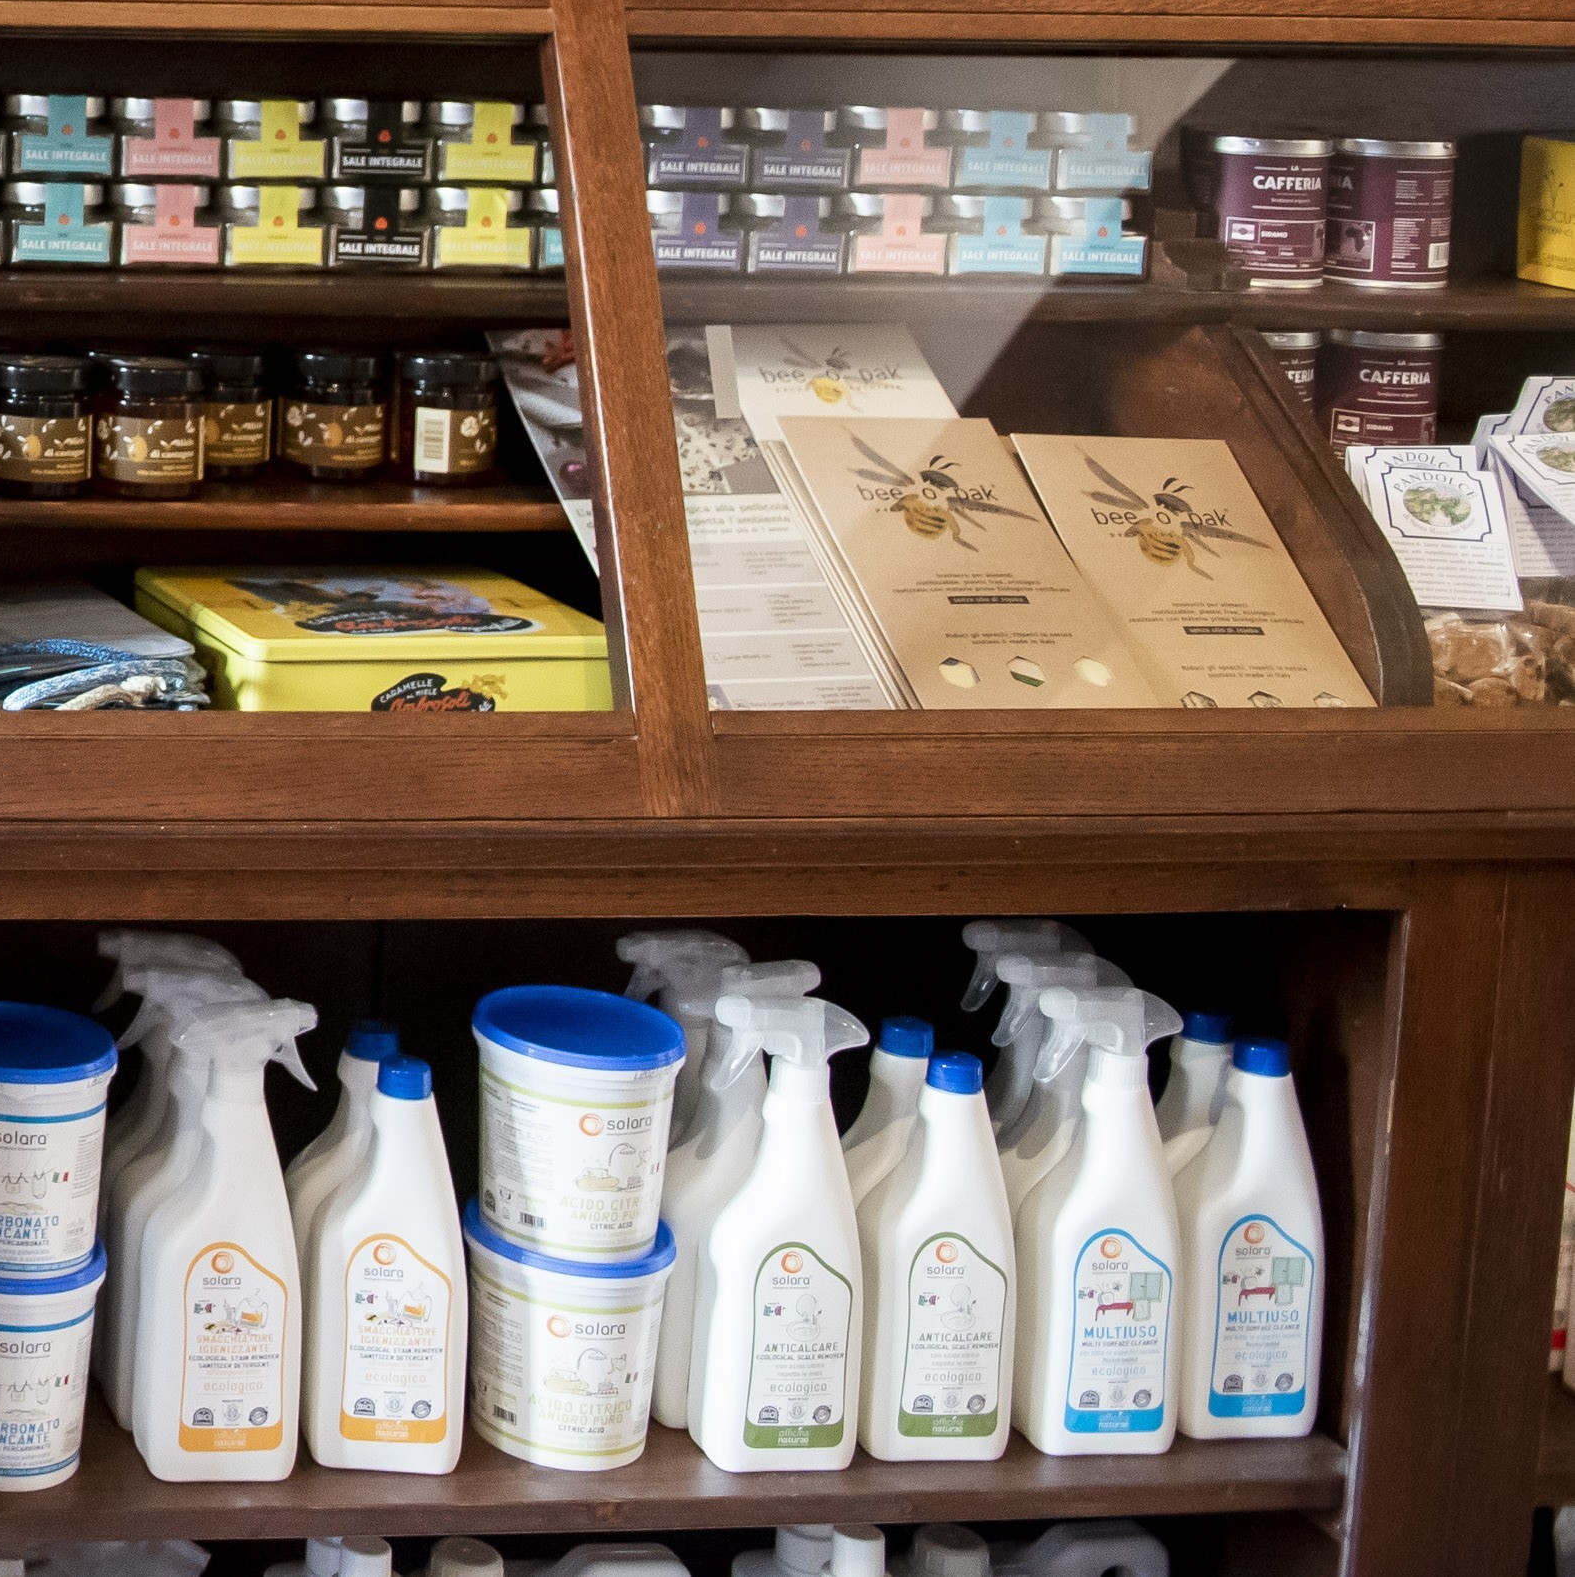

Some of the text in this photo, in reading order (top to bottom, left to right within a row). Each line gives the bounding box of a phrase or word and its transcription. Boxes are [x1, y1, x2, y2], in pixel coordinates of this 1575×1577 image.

[660, 162, 740, 173] SALE INTEGRALE
[1253, 175, 1322, 191] CAFFERIA
[338, 242, 420, 255] SALE INTEGRALE
[1360, 369, 1430, 385] CAFFERIA
[857, 483, 1000, 505] bee o pak
[203, 1275, 241, 1286] solara
[1227, 1310, 1298, 1323] MULTIUSO
[575, 1322, 626, 1336] solara
[1084, 1326, 1157, 1338] MULTIUSO
[764, 1342, 838, 1352] ANTICALCARE
[770, 1382, 827, 1394] ecologico
